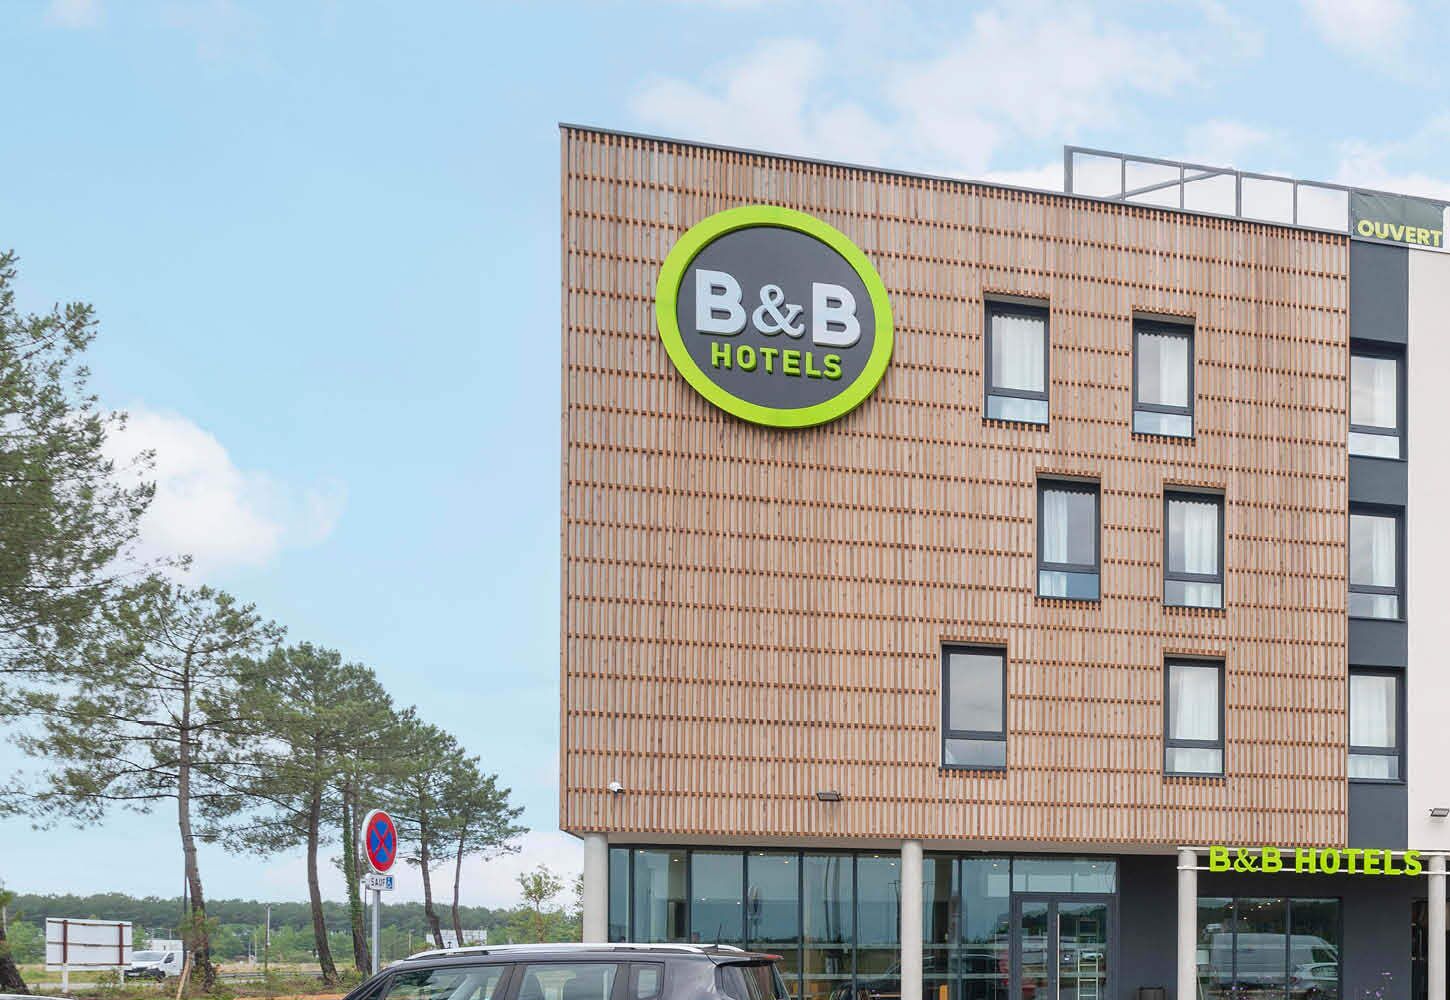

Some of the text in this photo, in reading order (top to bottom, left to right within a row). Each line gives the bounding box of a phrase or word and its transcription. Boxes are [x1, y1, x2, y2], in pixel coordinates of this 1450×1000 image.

[1357, 219, 1442, 247] OUVERT
[695, 268, 861, 348] B&B
[711, 342, 843, 381] HOTELS
[1209, 845, 1423, 876] B&B HOTELS
[370, 877, 386, 887] SAUF
